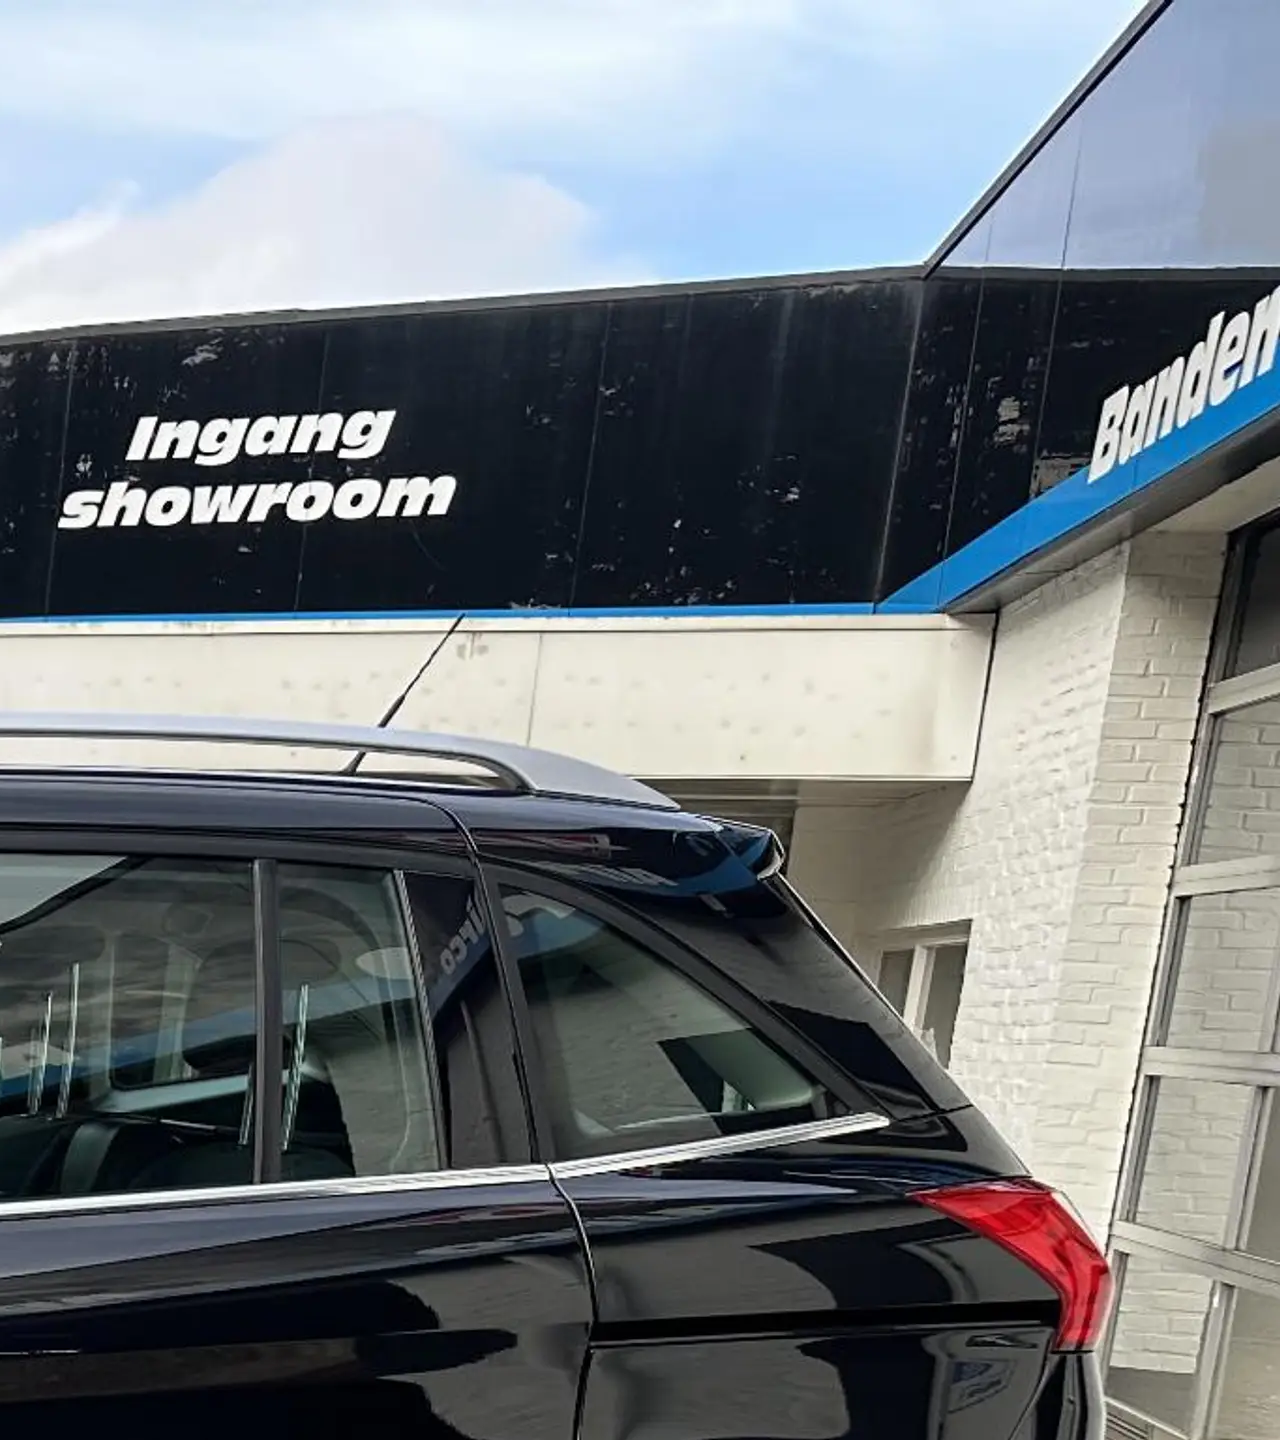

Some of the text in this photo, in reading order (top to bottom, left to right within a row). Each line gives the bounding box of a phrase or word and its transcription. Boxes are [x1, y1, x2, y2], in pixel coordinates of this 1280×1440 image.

[1087, 285, 1280, 485] Banden
[125, 409, 397, 466] Ingang
[57, 473, 458, 530] showroom
